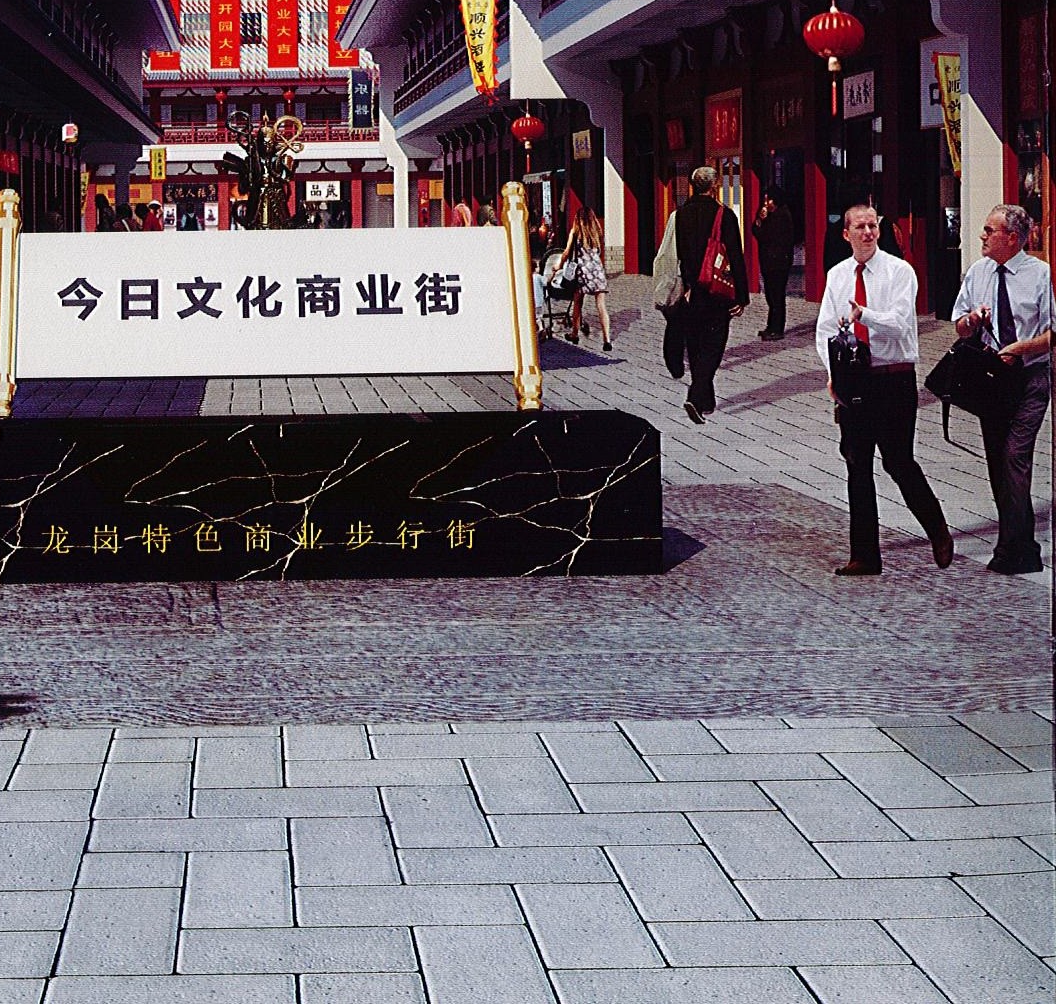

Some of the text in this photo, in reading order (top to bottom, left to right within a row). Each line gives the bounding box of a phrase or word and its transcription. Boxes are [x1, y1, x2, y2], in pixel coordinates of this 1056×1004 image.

[56, 272, 463, 320] 今日文化商业街
[41, 519, 476, 555] 龙岗特色商业步行街
